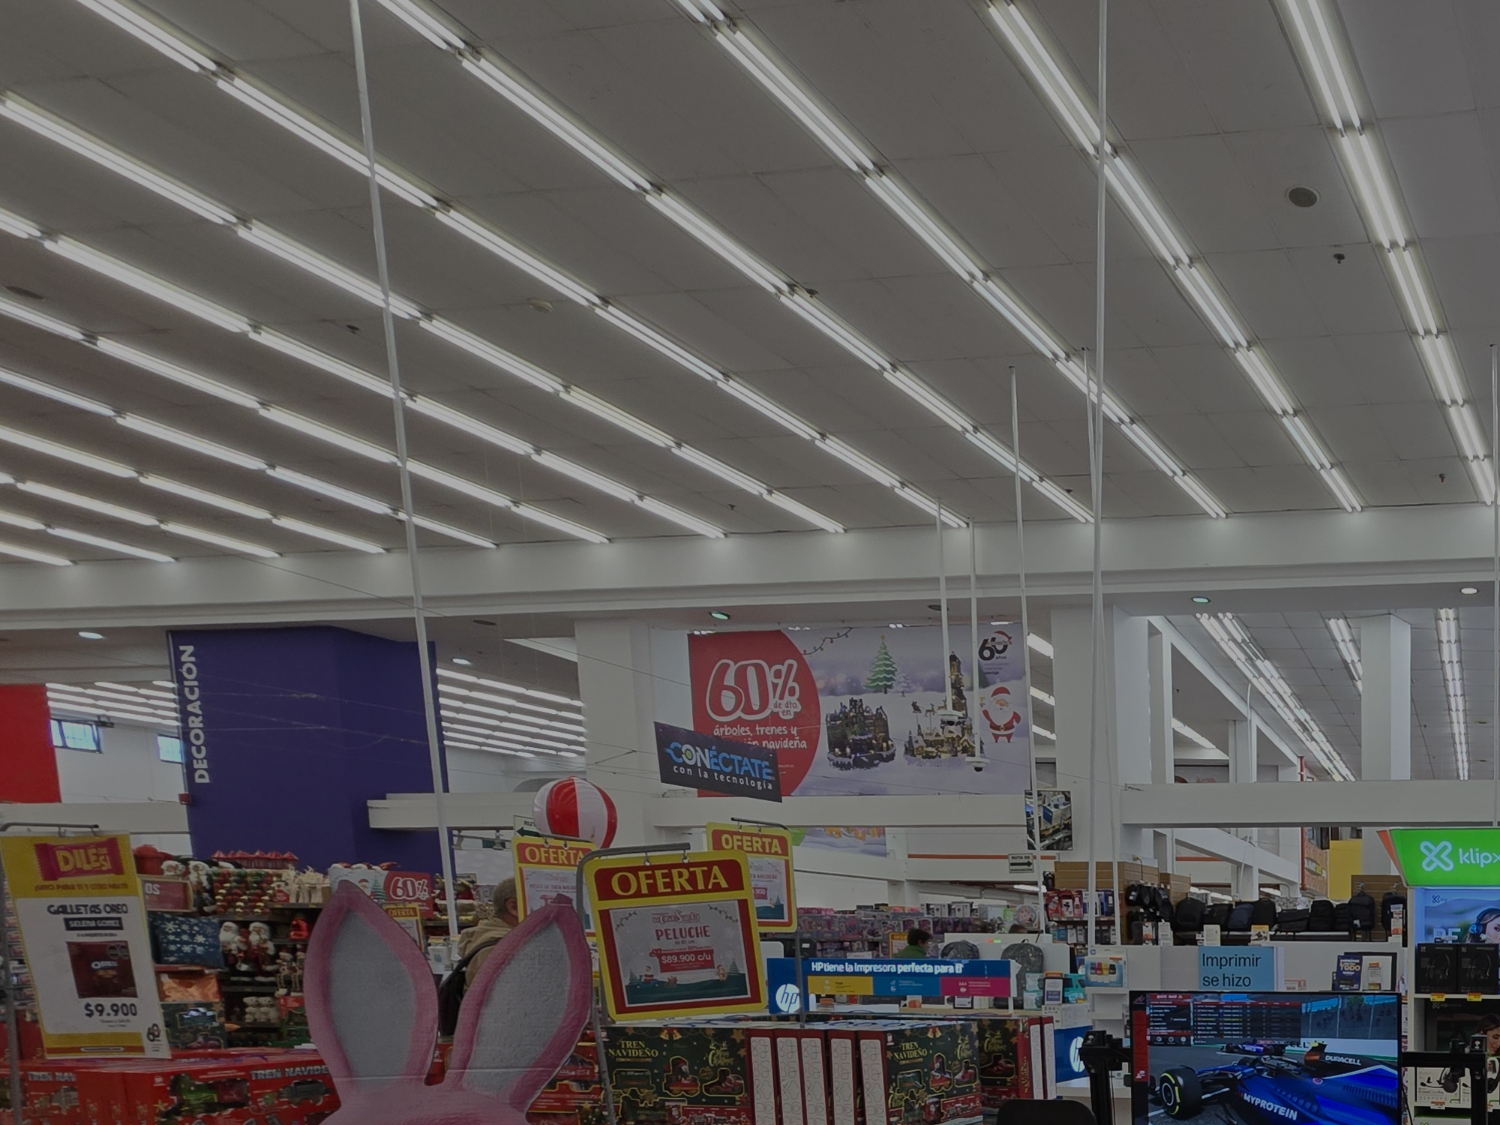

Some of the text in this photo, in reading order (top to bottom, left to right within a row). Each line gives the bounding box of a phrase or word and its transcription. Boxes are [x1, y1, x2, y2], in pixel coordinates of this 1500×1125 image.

[706, 658, 800, 722] 60%
[179, 644, 211, 785] DECORACIÓN
[713, 724, 798, 737] árboles, trenes y
[762, 736, 808, 749] navideña
[664, 741, 774, 781] CONÉCTATE
[673, 765, 773, 791] con la tecnología
[721, 834, 783, 855] OFERTA
[525, 846, 583, 865] OFERTA
[390, 876, 429, 899] 60%
[610, 865, 730, 897] OFERTA
[47, 903, 129, 915] GALLETAS OREO
[388, 907, 415, 918] OFERTA
[655, 925, 711, 941] PELUCHE
[811, 962, 824, 971] HP
[824, 962, 845, 972] tiene
[845, 962, 855, 972] la
[897, 962, 934, 974] perfecta
[934, 964, 954, 975] para
[1201, 951, 1262, 970] Imprimir
[1202, 973, 1252, 987] se hizo
[84, 1002, 138, 1018] $9.900
[608, 1047, 659, 1058] NAVIDEÑO
[620, 1040, 646, 1049] TREN
[1324, 1054, 1362, 1067] DURACELL
[251, 1069, 282, 1080] TREN
[1243, 1093, 1299, 1121] MYPROTEIN
